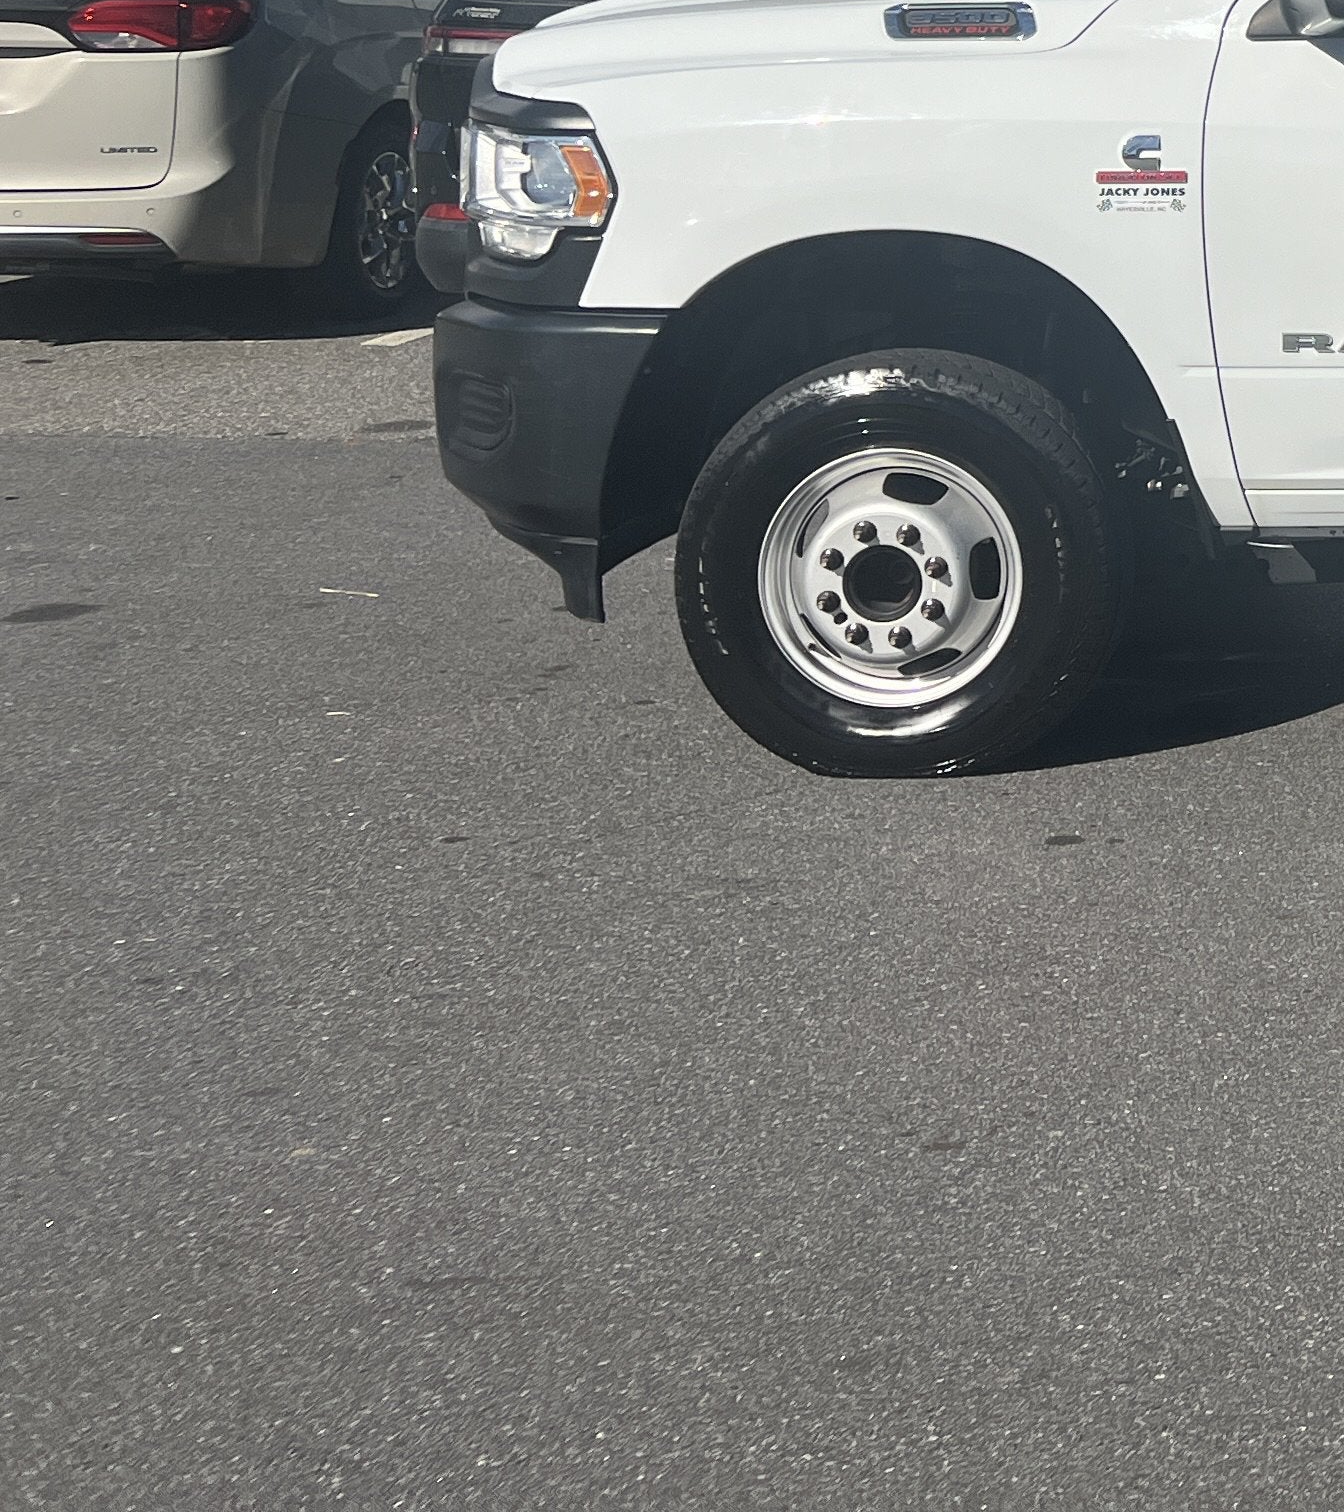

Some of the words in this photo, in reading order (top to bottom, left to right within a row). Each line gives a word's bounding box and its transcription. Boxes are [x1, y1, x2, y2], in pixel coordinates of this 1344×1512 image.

[910, 26, 963, 35] HEAVY
[965, 25, 1010, 34] DUTY
[1098, 187, 1140, 197] JACKY
[1143, 187, 1186, 197] JONES
